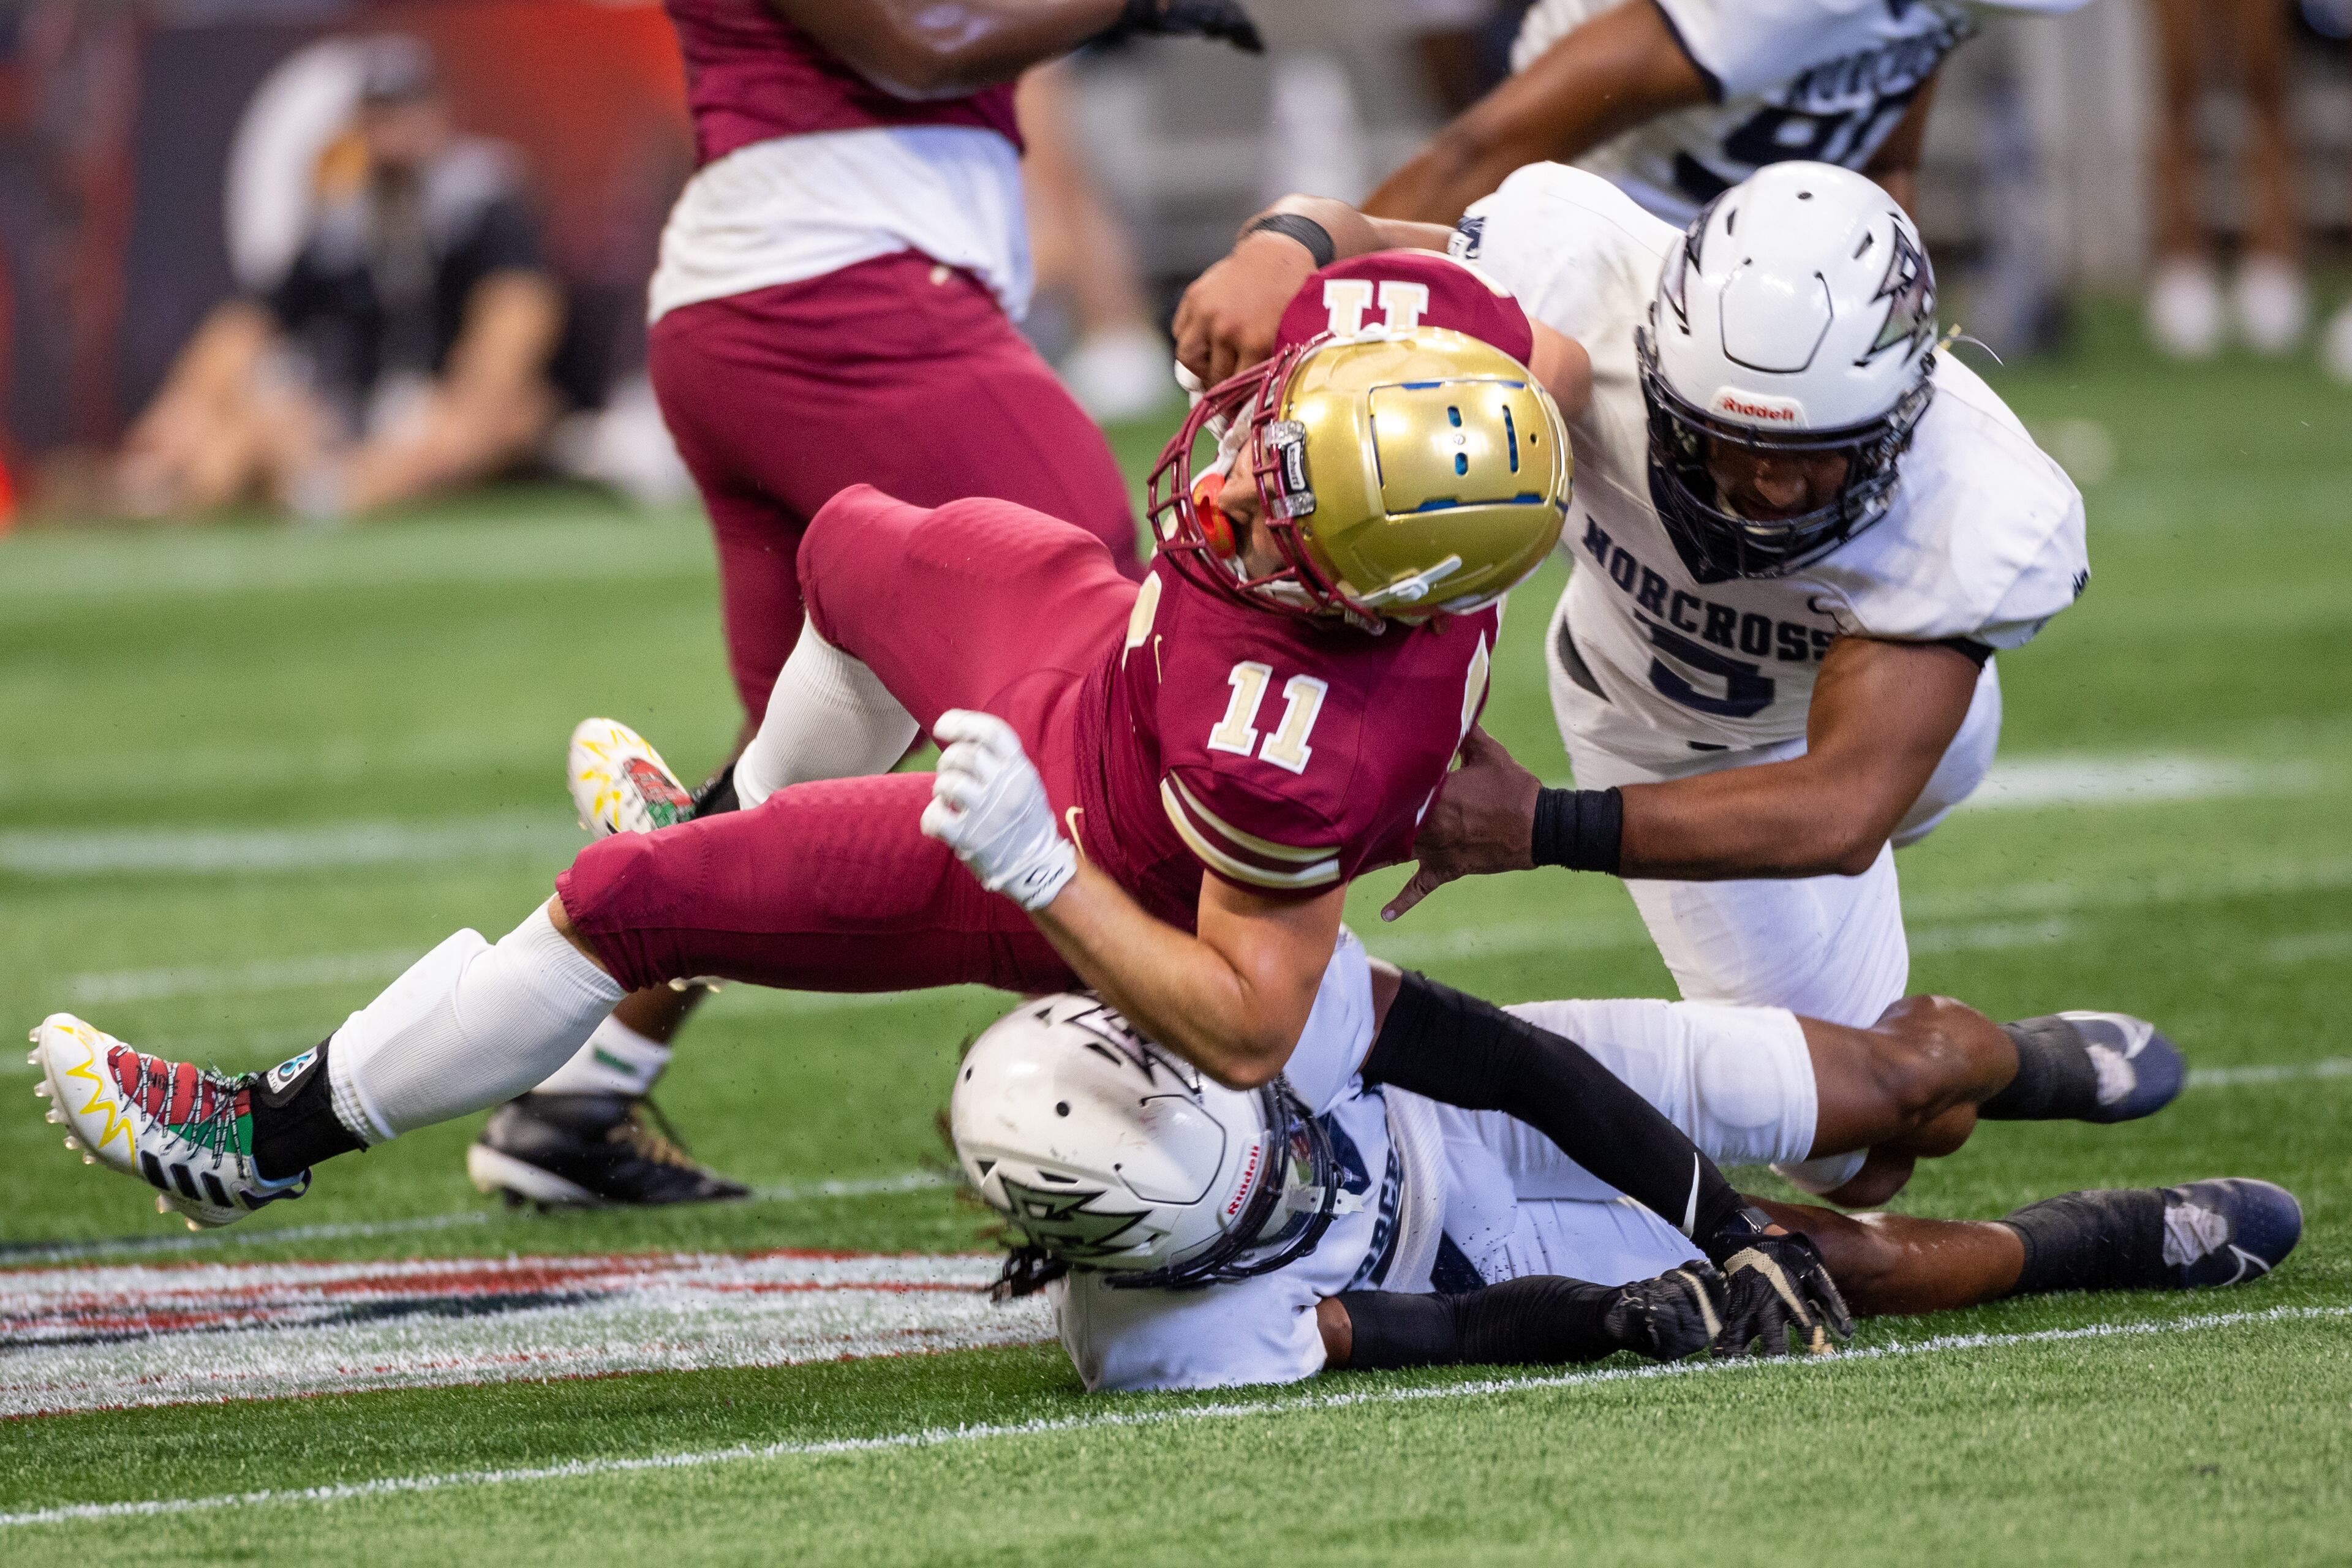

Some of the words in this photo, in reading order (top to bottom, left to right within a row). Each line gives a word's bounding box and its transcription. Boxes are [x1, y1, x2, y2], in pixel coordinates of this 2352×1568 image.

[1722, 397, 1795, 422] Riddell
[1207, 660, 1329, 775] 11
[1227, 1145, 1261, 1216] Riddell
